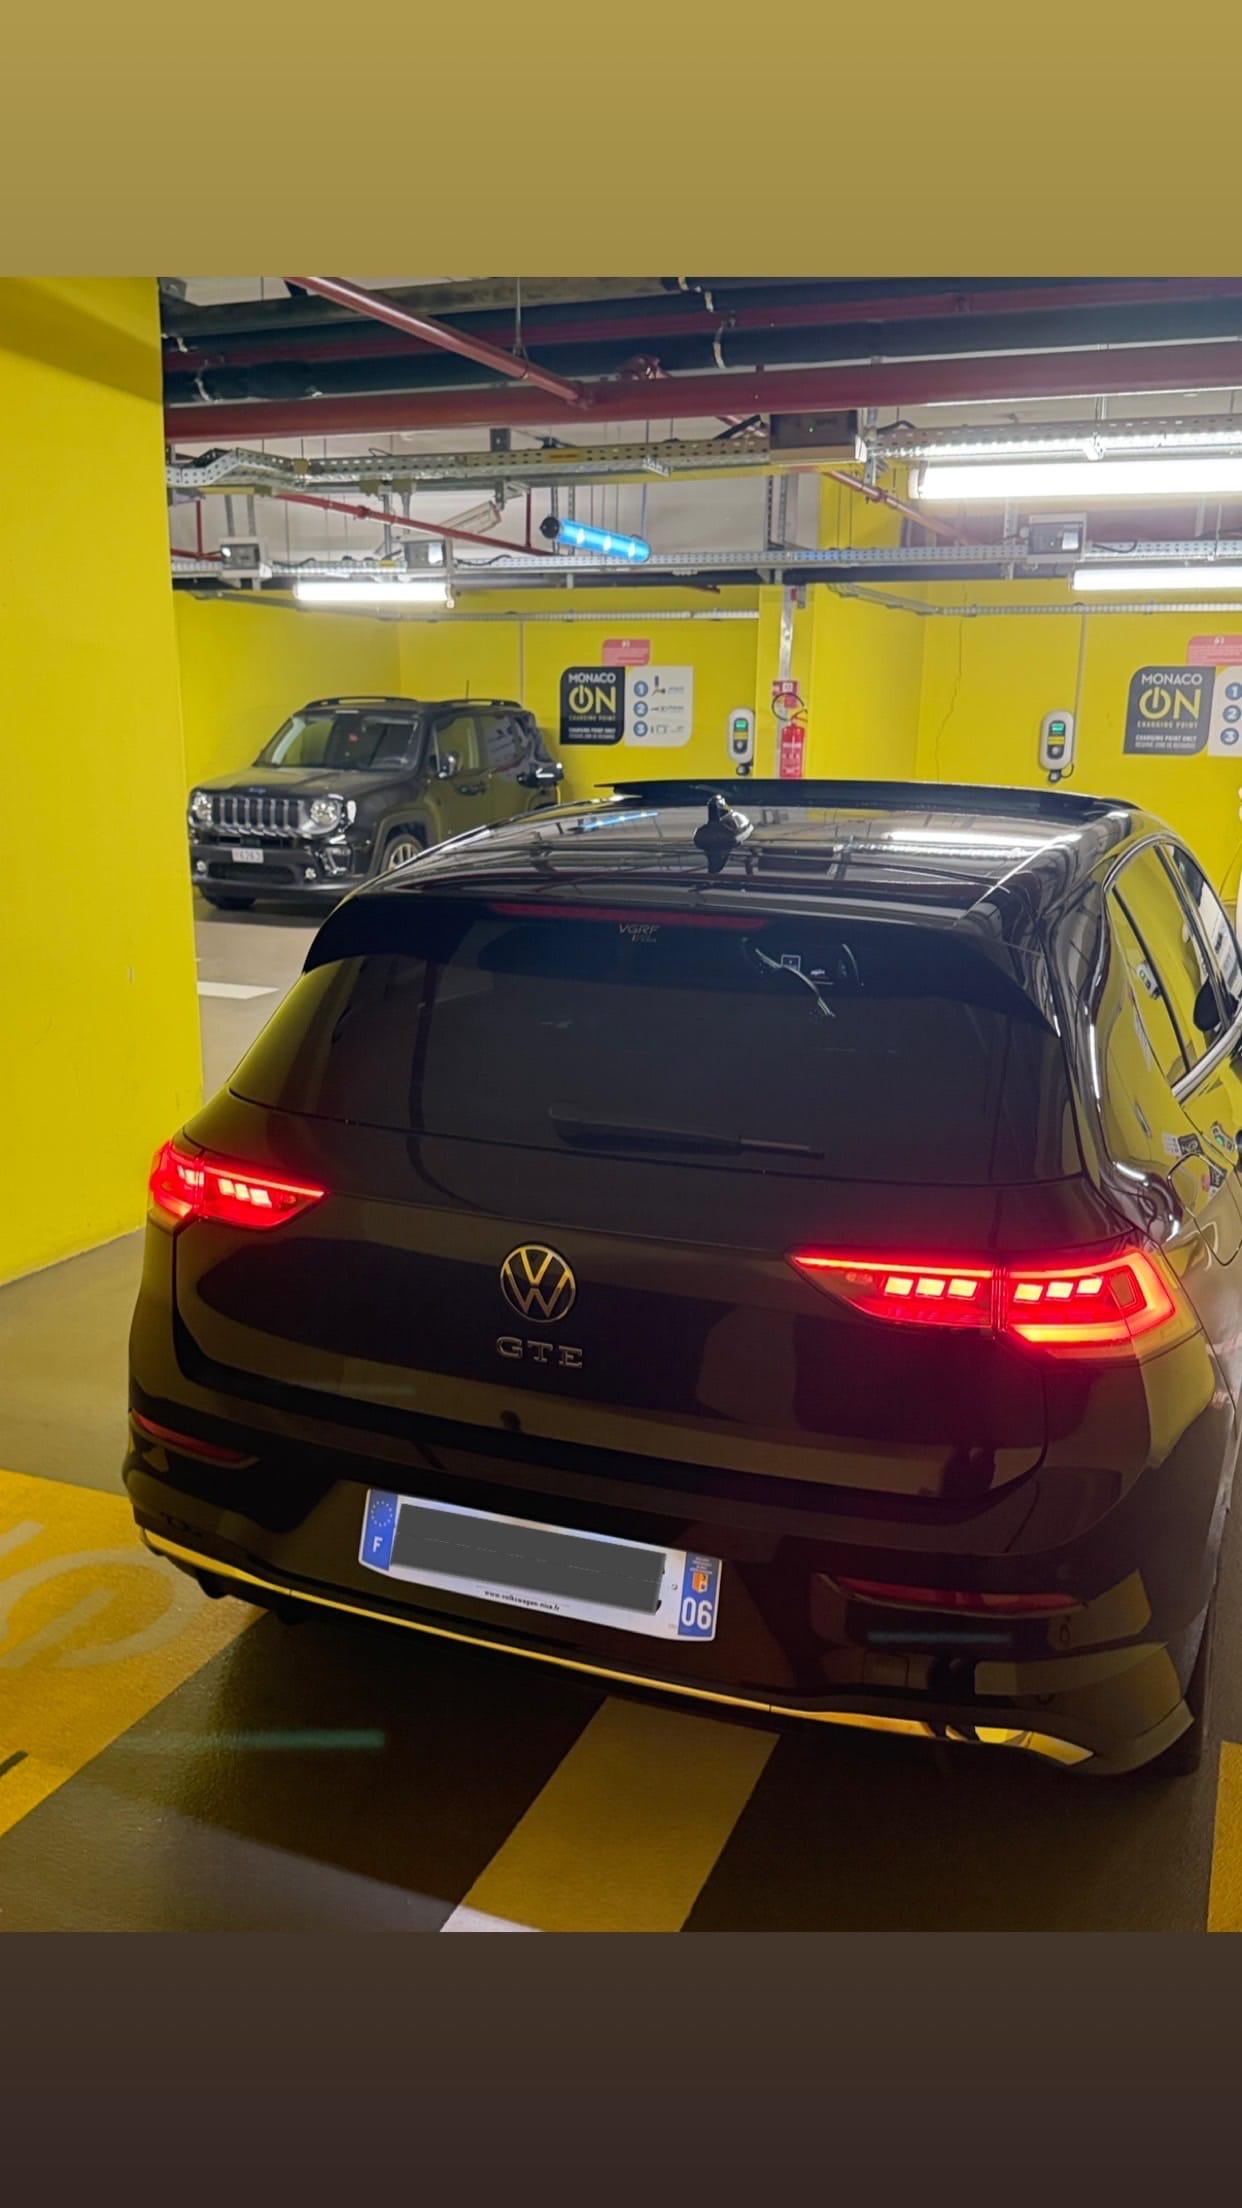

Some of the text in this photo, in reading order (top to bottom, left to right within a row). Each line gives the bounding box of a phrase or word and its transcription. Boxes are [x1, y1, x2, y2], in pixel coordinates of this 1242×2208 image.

[568, 672, 617, 683] MONACO
[1141, 673, 1203, 685] MONACO
[568, 685, 617, 714] ON
[1139, 686, 1201, 720] ON
[496, 1336, 583, 1369] GTE
[372, 1535, 384, 1553] F
[681, 1596, 713, 1630] 06
